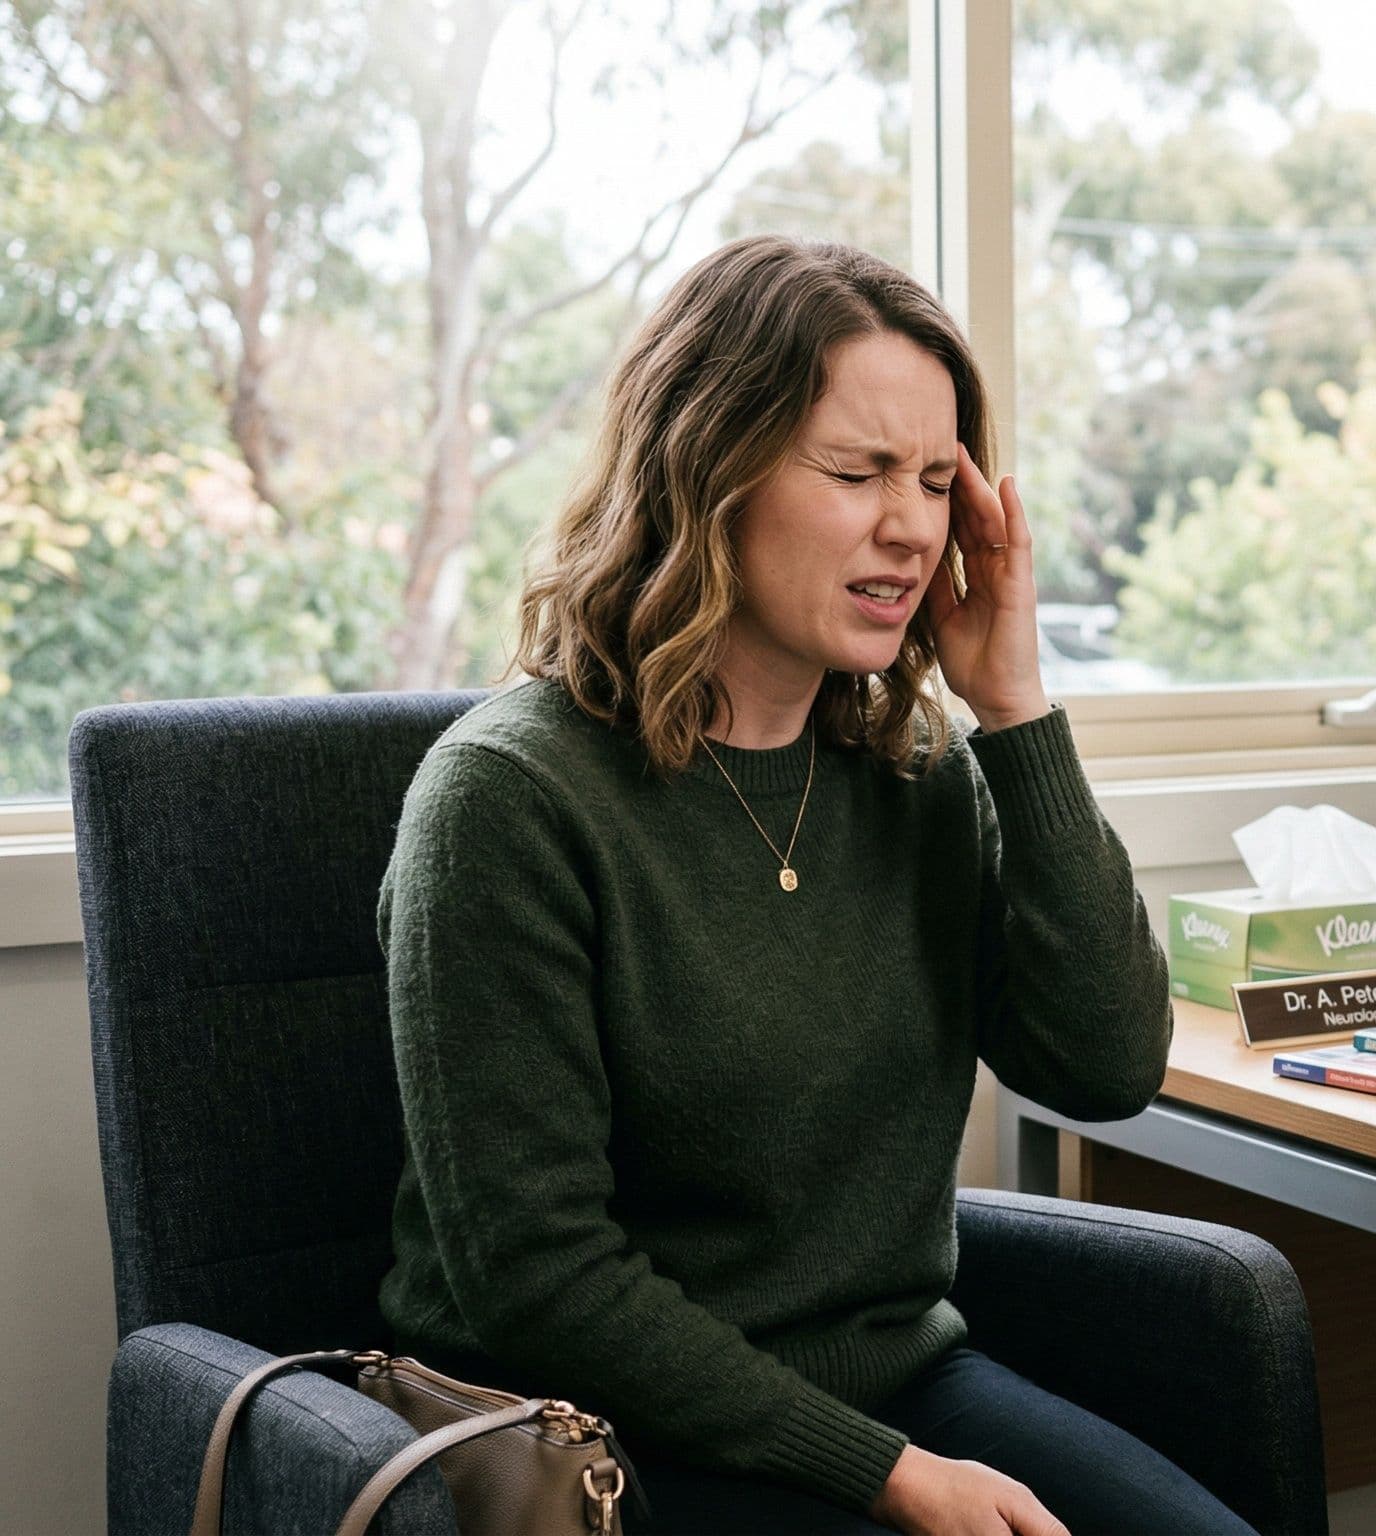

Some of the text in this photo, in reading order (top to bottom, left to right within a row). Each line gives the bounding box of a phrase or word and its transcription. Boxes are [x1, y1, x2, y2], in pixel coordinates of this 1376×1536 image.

[1181, 911, 1231, 949] Kleenex
[1284, 991, 1312, 1012] Dr.
[1317, 987, 1337, 1009] A.
